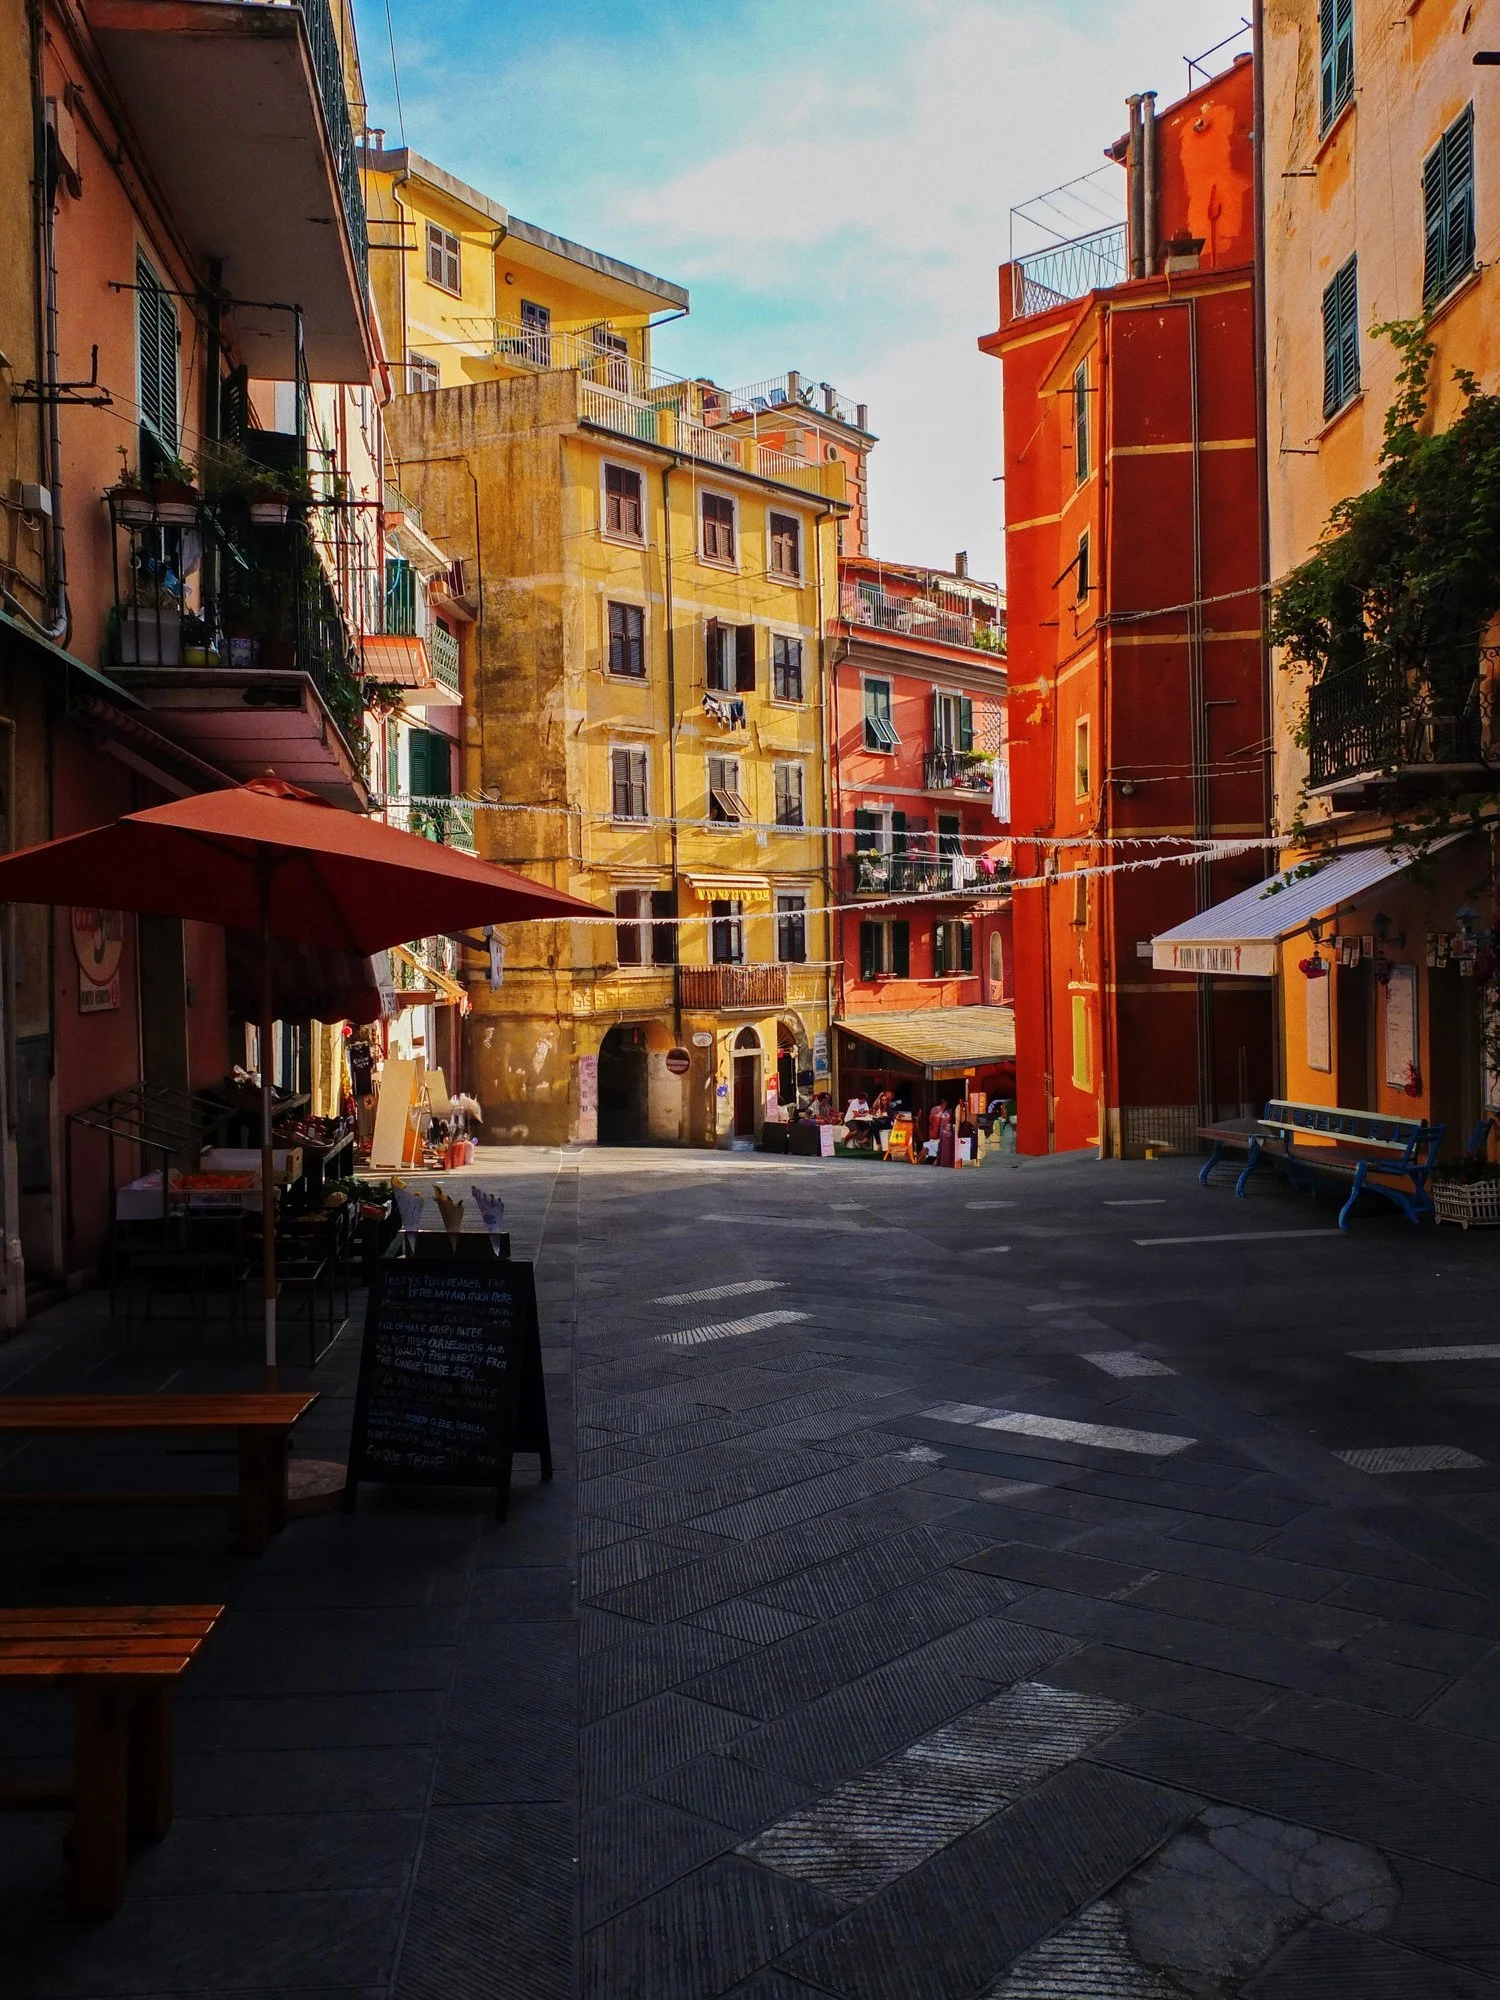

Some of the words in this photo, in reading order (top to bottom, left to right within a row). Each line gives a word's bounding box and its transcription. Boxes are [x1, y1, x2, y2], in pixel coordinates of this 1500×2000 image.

[418, 1288, 432, 1298] THE
[435, 1289, 450, 1300] DAY
[450, 1290, 466, 1300] AND
[468, 1291, 489, 1302] MUCH
[491, 1292, 513, 1304] MORE
[429, 1325, 454, 1338] CRISPY
[428, 1339, 444, 1349] OUR
[486, 1344, 505, 1354] AND
[376, 1354, 392, 1366] THE
[395, 1358, 422, 1371] CINQUE
[422, 1362, 450, 1376] TERRE
[429, 1350, 447, 1361] FISH
[486, 1356, 508, 1370] FROM
[366, 1444, 401, 1466] CINQUE
[407, 1453, 446, 1470] TERRE
